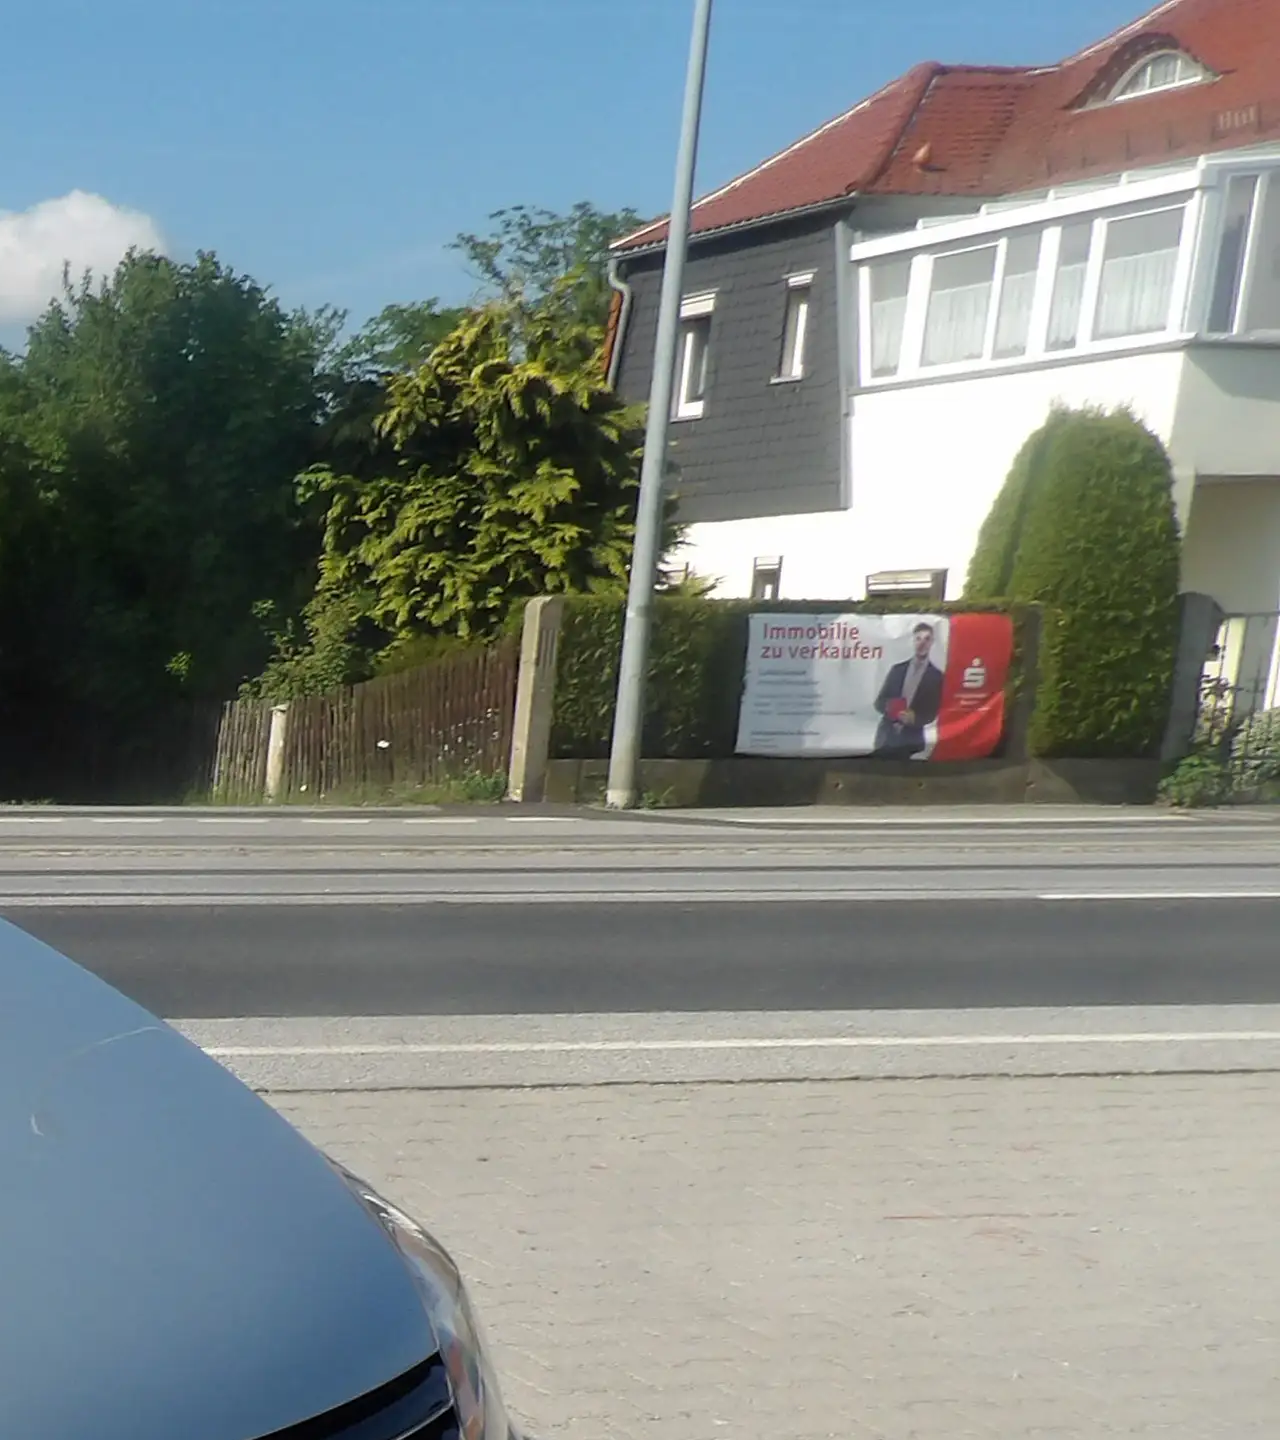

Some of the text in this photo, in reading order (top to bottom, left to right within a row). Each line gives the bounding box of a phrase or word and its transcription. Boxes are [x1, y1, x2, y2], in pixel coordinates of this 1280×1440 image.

[763, 622, 859, 640] Immobilie
[760, 641, 883, 659] zu verkaufen
